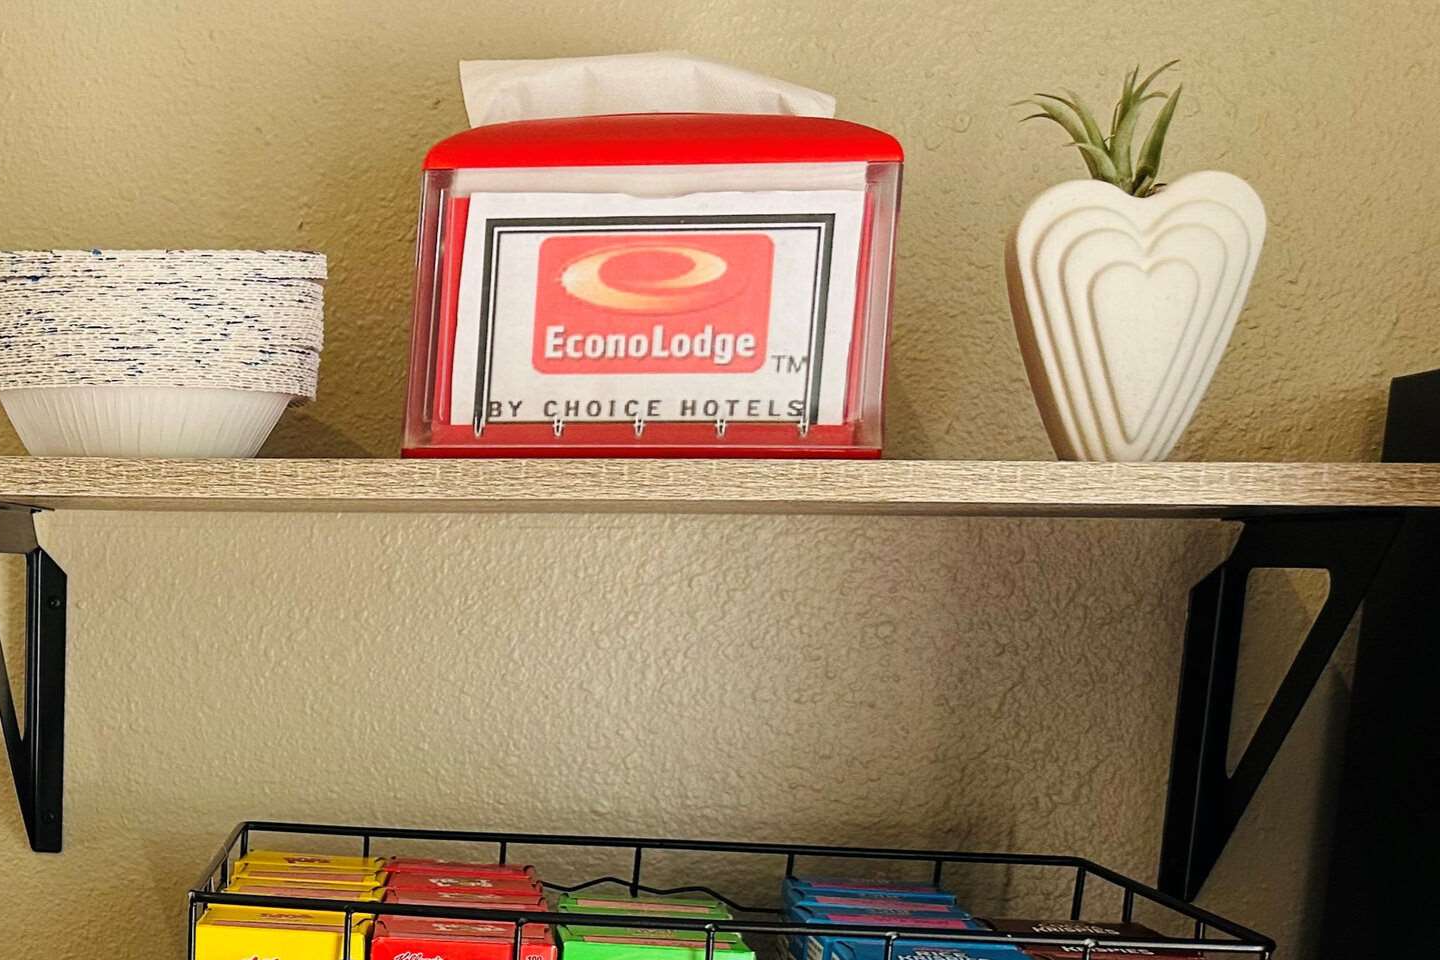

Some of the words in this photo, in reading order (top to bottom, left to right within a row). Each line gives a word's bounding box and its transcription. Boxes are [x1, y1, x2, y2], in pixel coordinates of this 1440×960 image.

[544, 324, 757, 364] EconoLodge
[771, 354, 807, 374] TM
[488, 400, 522, 418] BY
[543, 399, 663, 418] CHOICE
[680, 399, 806, 418] HOTELS
